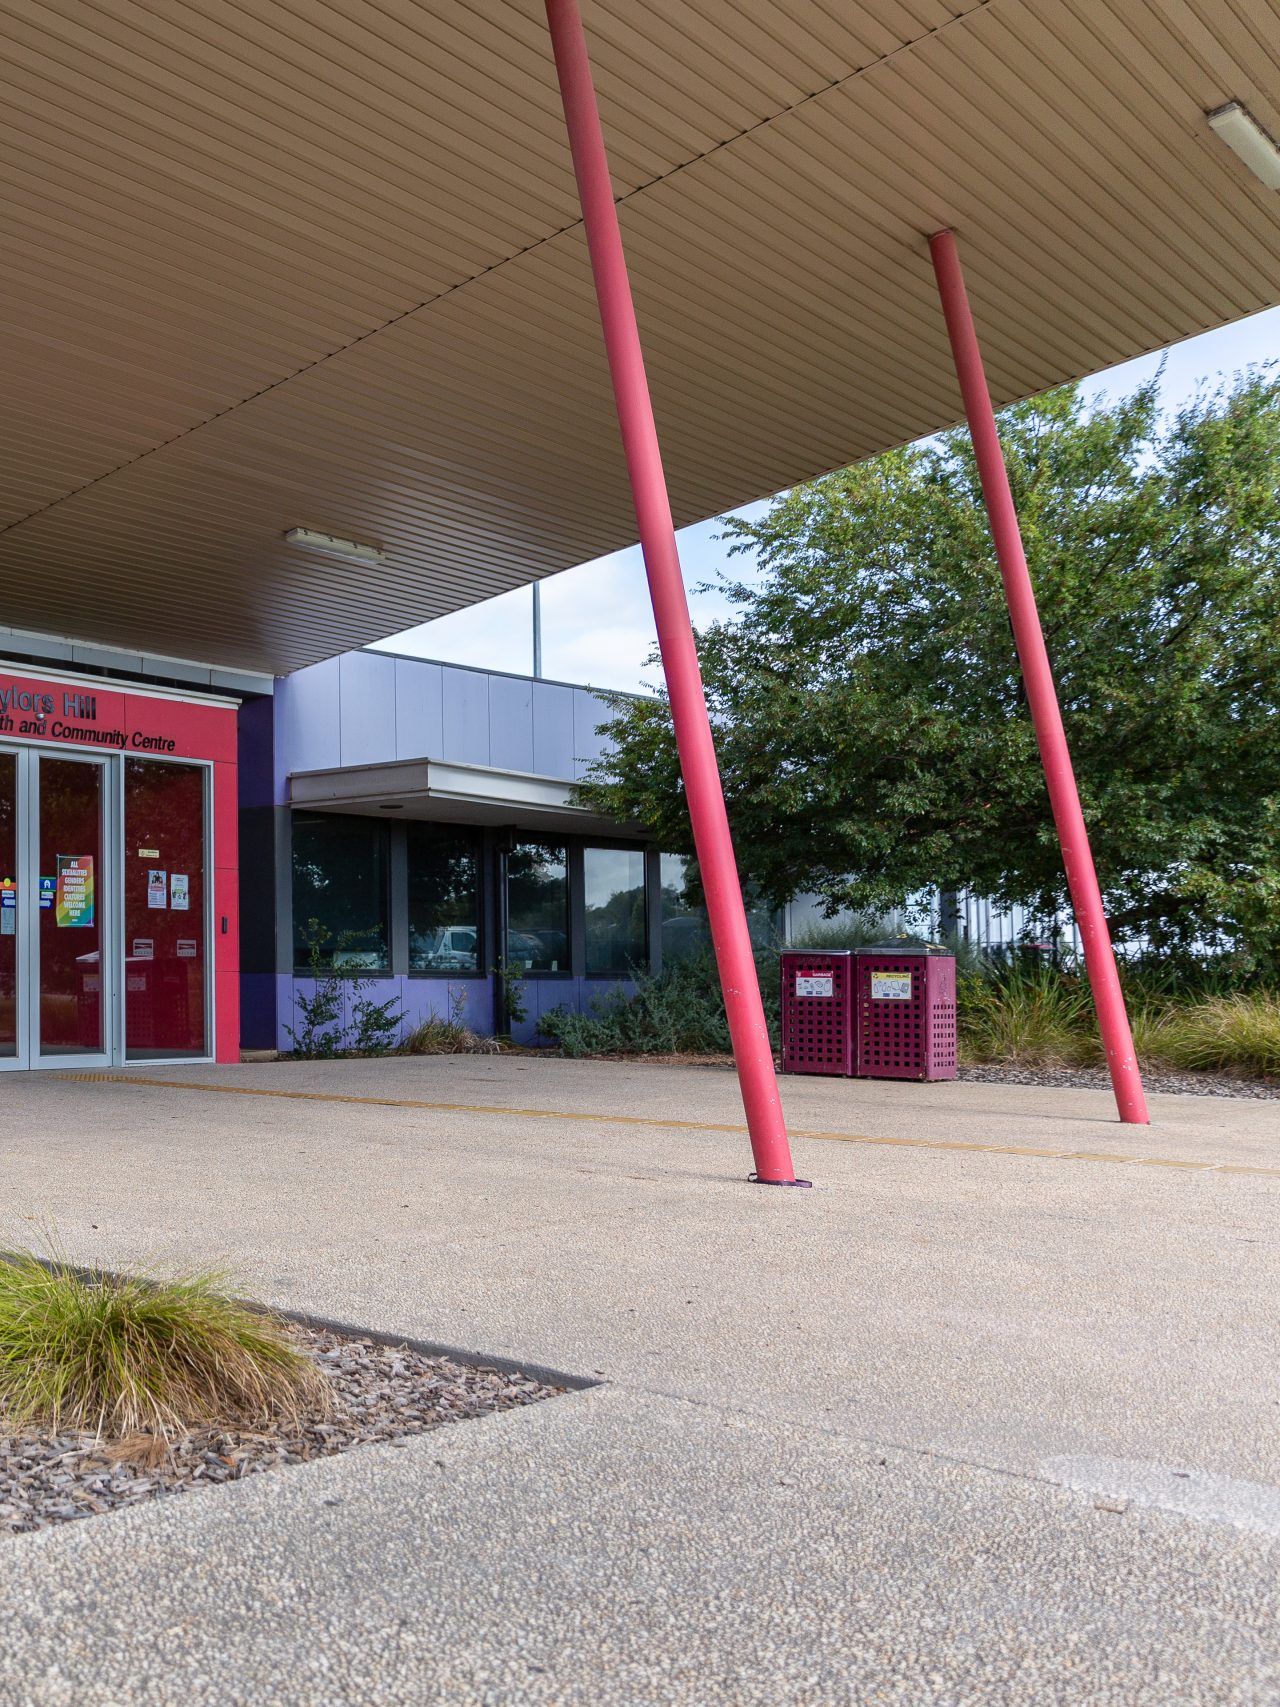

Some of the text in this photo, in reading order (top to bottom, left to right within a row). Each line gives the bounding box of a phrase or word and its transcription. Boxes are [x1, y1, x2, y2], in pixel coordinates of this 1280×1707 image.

[63, 692, 97, 720] Hill
[19, 719, 47, 736] and
[51, 721, 128, 750] Community
[131, 731, 176, 752] Centre
[70, 860, 78, 868] ALL
